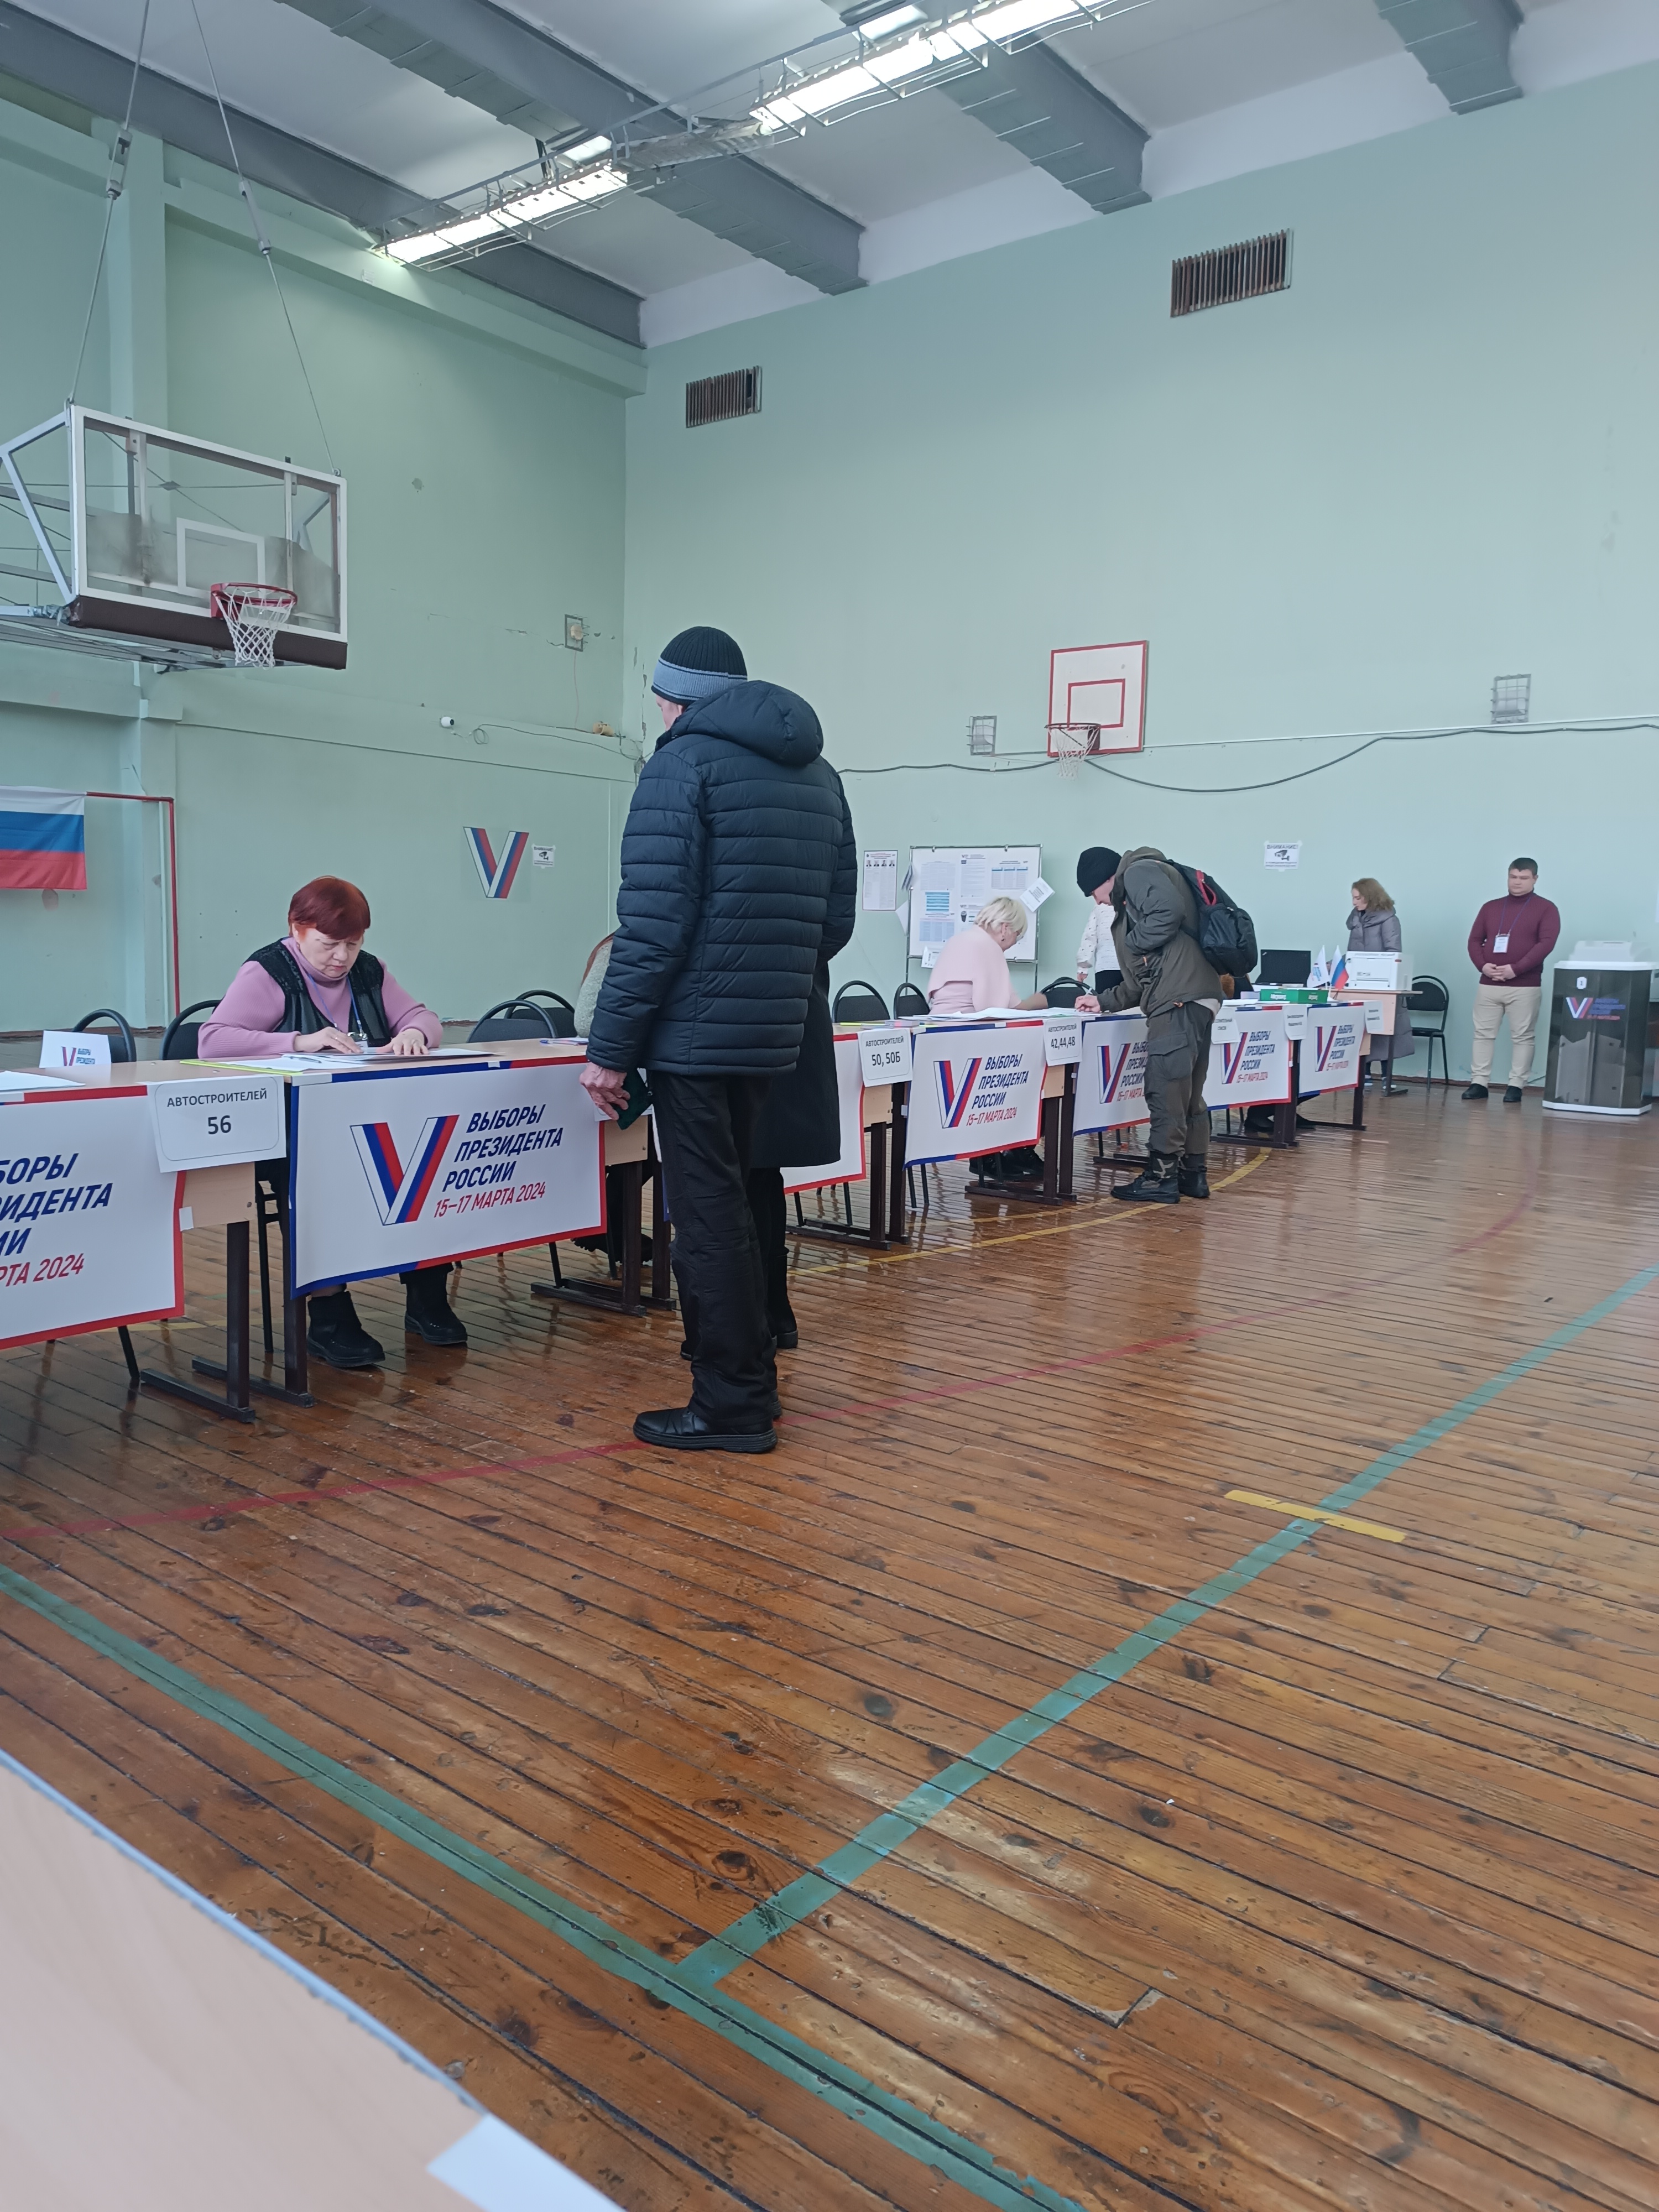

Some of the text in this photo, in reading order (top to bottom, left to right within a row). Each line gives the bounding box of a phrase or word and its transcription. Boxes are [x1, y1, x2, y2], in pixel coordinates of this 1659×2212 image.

[865, 1036, 904, 1047] АВТОСТРОИТЕЛЕЙ
[1051, 1036, 1075, 1050] 42,44,48
[872, 1054, 884, 1067] 50,
[985, 1053, 1023, 1071] ВЫБОРЫ
[978, 1071, 1029, 1089] ПРЕЗИДЕНТА
[167, 1088, 267, 1107] АВТОСТРОИТЕЛЕЙ
[972, 1092, 1007, 1109] РОССИИ
[208, 1115, 231, 1134] 56
[466, 1104, 546, 1133] ВЫБОРЫ
[984, 1109, 1004, 1124] МАРТА
[1004, 1107, 1018, 1120] 2024
[454, 1128, 563, 1162] ПРЕЗИДЕНТА
[442, 1161, 517, 1192] РОССИИ
[471, 1187, 515, 1211] МАРТА
[515, 1182, 546, 1203] 2024
[33, 1253, 85, 1282] 2024
